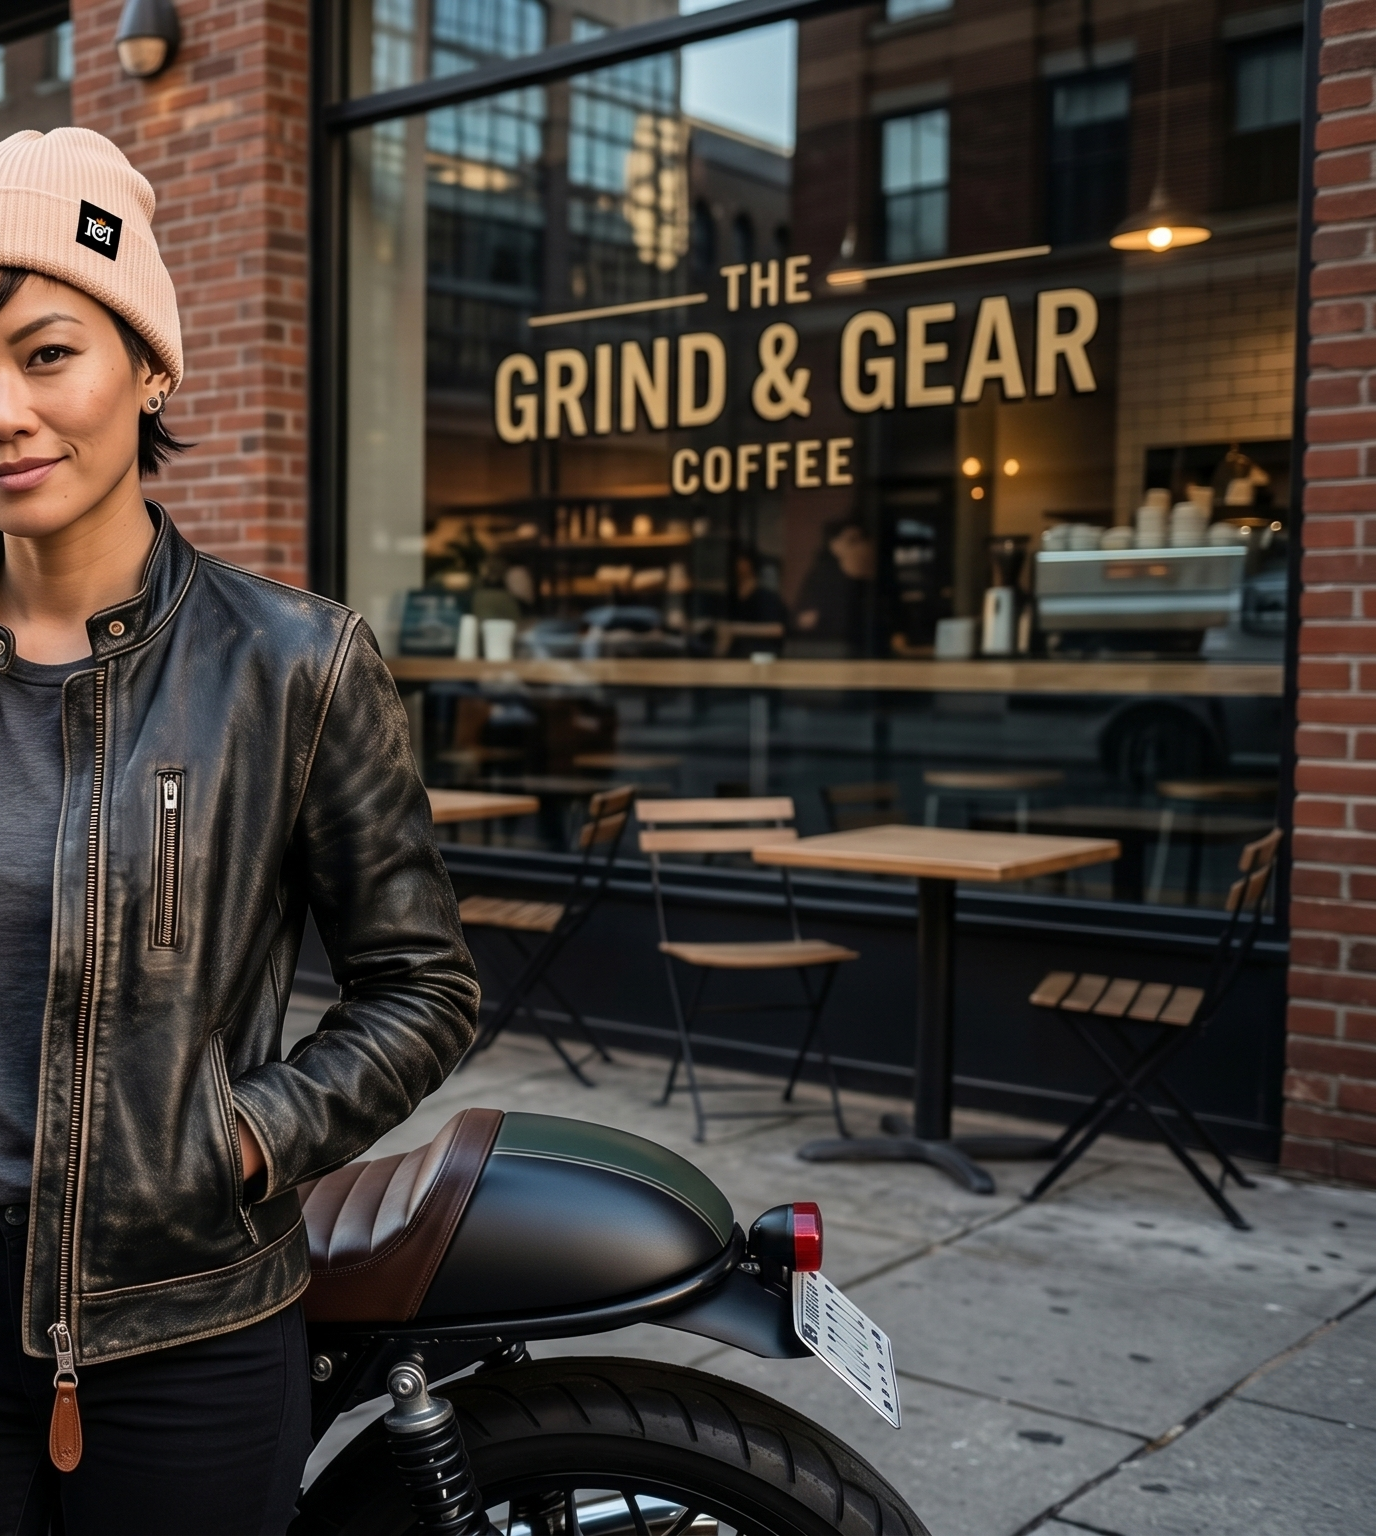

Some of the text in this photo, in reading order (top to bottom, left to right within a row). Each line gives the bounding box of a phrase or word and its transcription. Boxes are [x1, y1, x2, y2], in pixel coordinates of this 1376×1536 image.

[721, 256, 812, 311] THE
[495, 288, 1098, 444] GRIND & GEAR
[672, 438, 854, 494] COFFEE
